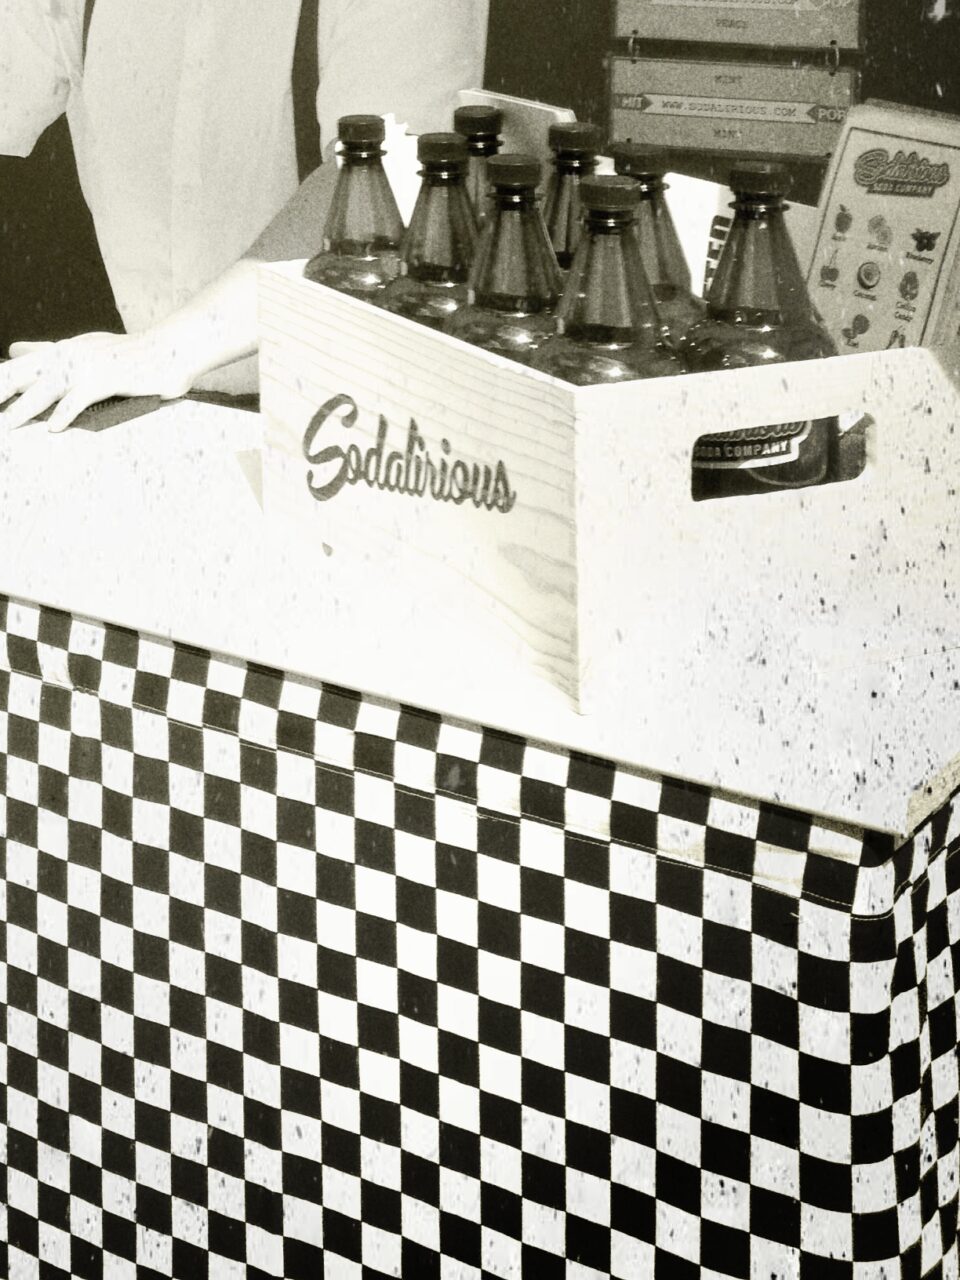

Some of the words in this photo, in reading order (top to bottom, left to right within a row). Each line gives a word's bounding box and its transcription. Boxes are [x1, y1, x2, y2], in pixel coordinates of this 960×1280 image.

[817, 107, 847, 122] POP
[302, 393, 517, 514] Sodalirious
[724, 440, 788, 458] COMPANY
